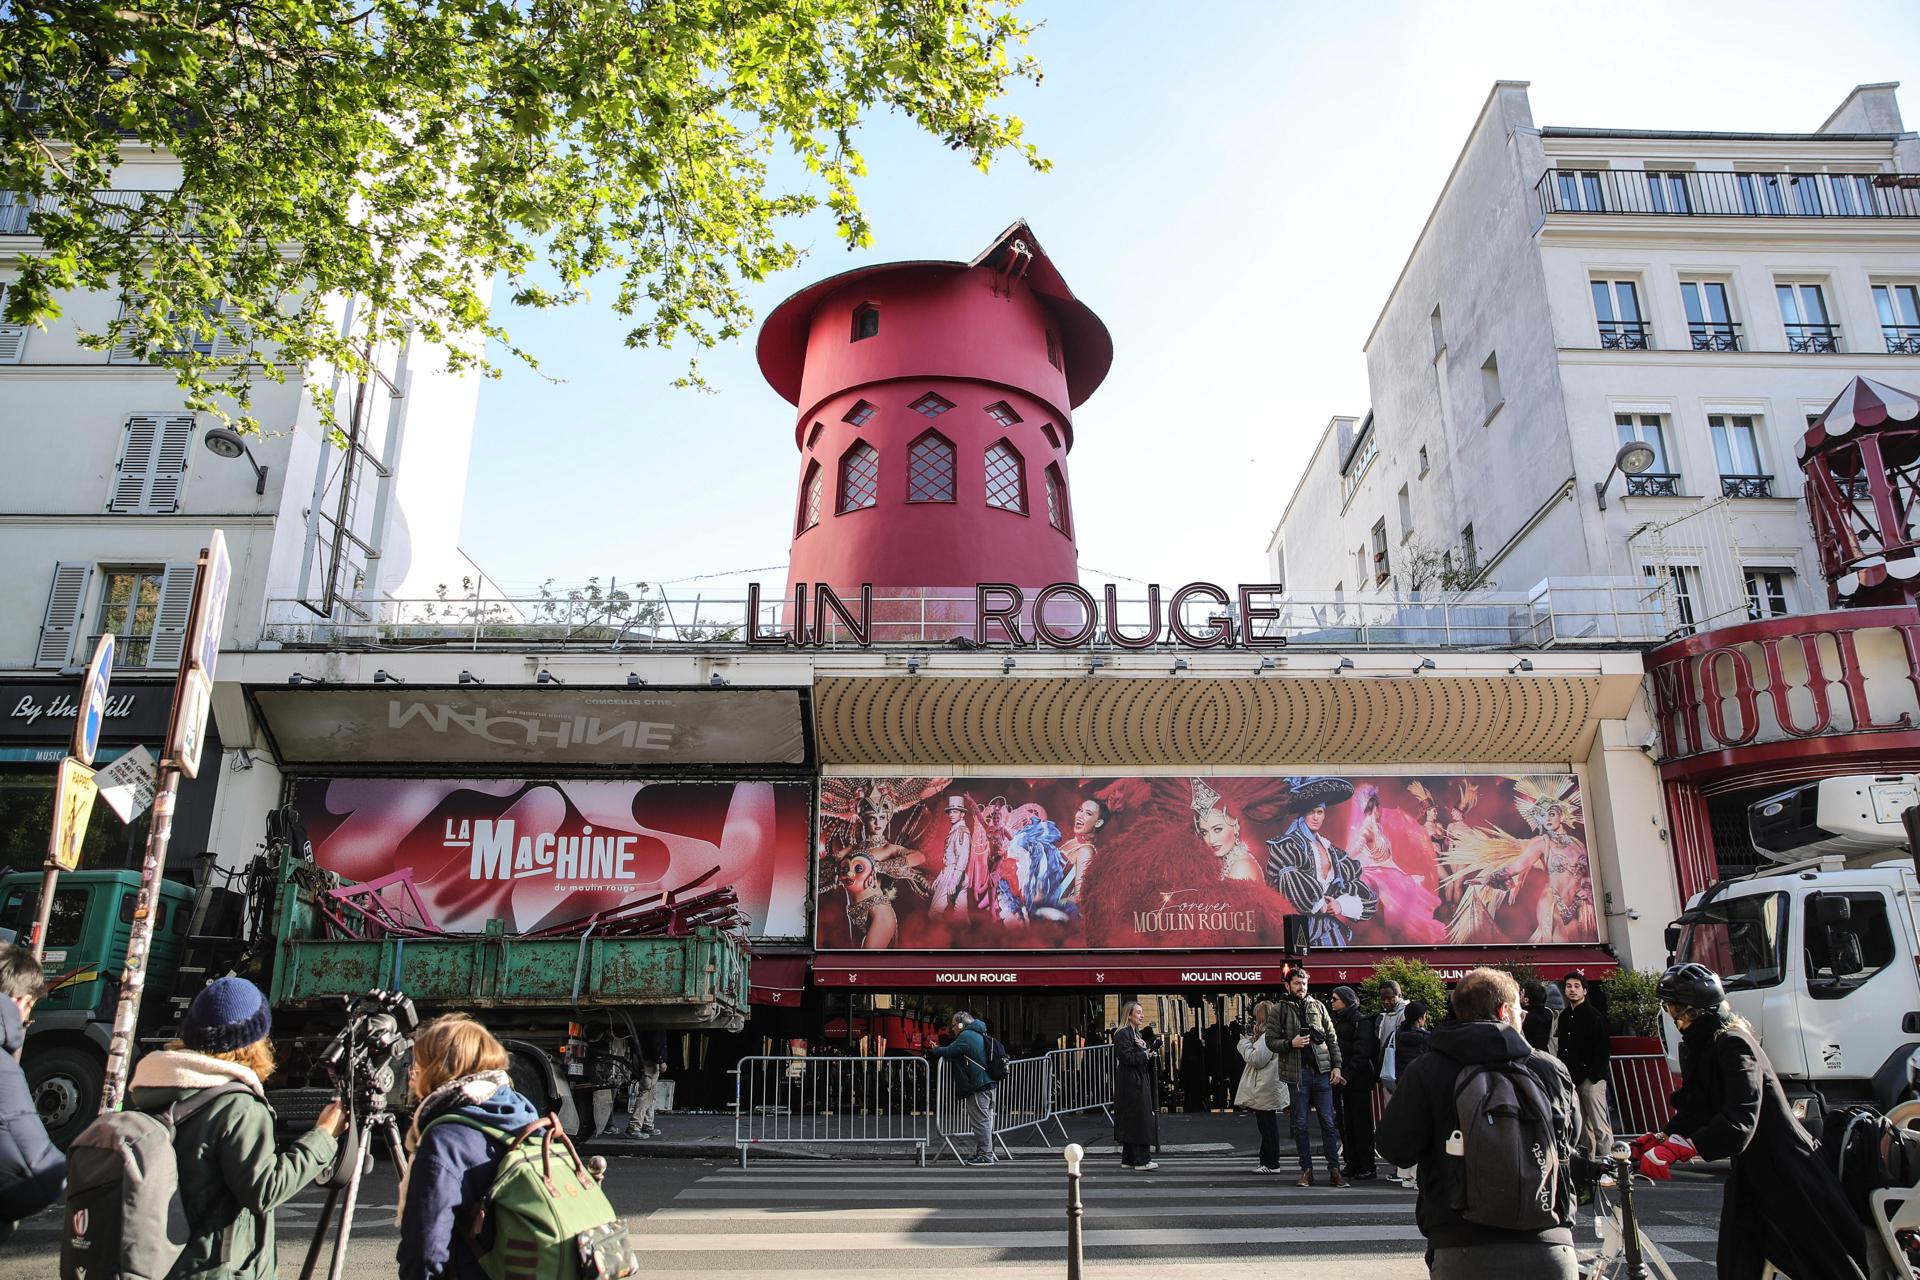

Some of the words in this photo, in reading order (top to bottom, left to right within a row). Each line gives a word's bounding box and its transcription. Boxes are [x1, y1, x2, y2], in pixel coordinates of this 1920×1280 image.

[748, 582, 872, 648] LIN
[976, 582, 1287, 649] ROUGE
[11, 695, 42, 725] By
[36, 751, 61, 761] MUSIC
[445, 819, 470, 840] LA
[554, 883, 566, 891] du
[569, 883, 603, 892] moulin
[606, 884, 636, 893] rouge
[1151, 888, 1231, 917] Forever
[1133, 911, 1194, 932] MOULIN
[1199, 910, 1256, 932] ROUGE
[936, 974, 977, 982] MOULIN
[980, 973, 1017, 982] ROUGE
[1181, 972, 1222, 981] MOULIN
[1225, 972, 1262, 980] ROUGE
